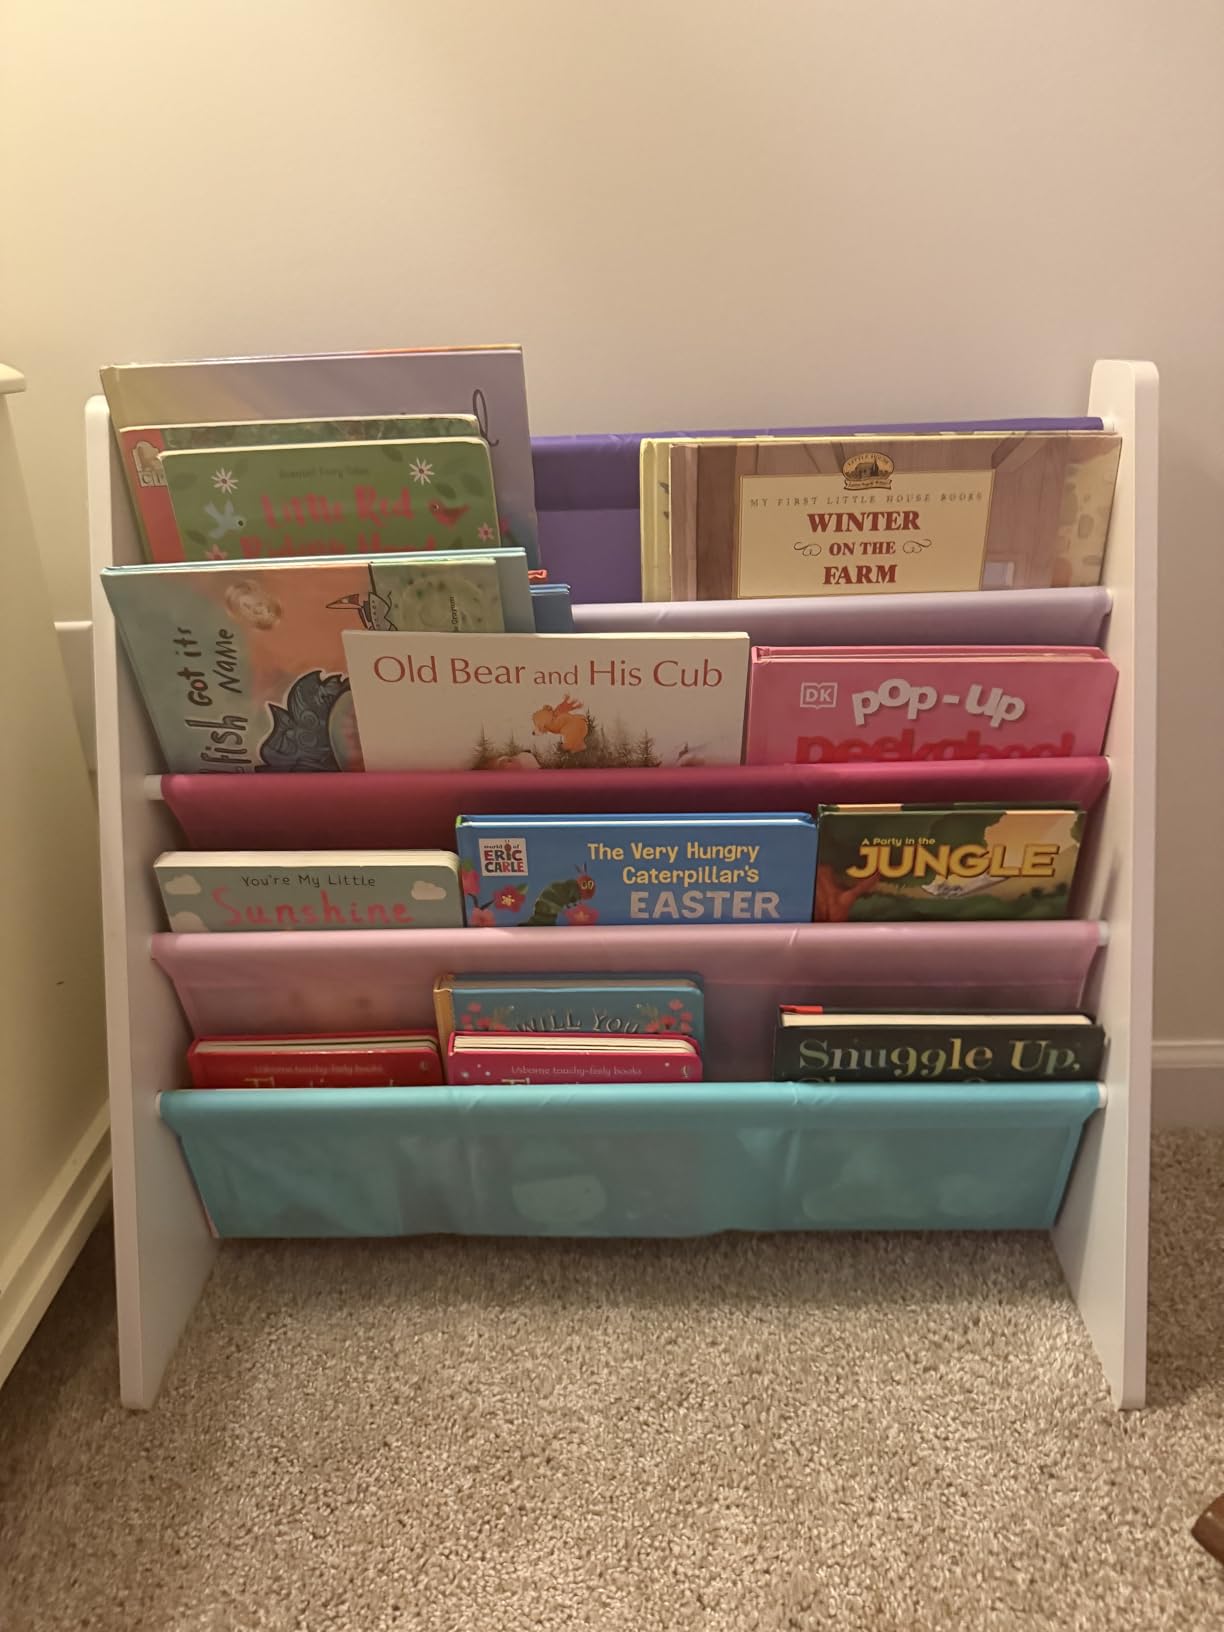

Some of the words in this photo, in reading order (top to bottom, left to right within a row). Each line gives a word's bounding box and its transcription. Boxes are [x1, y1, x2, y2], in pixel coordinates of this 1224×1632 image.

[260, 490, 345, 529] Little
[354, 484, 415, 528] Red
[750, 498, 769, 508] MY
[776, 496, 818, 507] FIRST
[826, 494, 877, 506] LITTLE
[885, 492, 931, 504] HOUSE
[940, 491, 983, 503] BOOKS
[807, 509, 921, 534] WINTER
[828, 541, 855, 556] ON
[859, 540, 897, 555] THE
[822, 563, 898, 586] FARM
[172, 626, 203, 658] its
[373, 653, 439, 685] Old
[450, 657, 527, 686] Bear
[533, 664, 579, 686] and
[588, 659, 643, 688] His
[652, 658, 724, 688] Cub
[176, 665, 214, 707] Got
[804, 688, 833, 703] DK
[587, 842, 624, 861] The
[630, 842, 678, 863] Very
[686, 841, 760, 863] Hungry
[861, 837, 871, 847] A
[872, 837, 903, 848] Party
[918, 836, 936, 846] the
[483, 849, 523, 862] ERIC
[845, 843, 1061, 880] JUNGLE
[484, 861, 525, 874] CARLE
[622, 865, 760, 888] Caterpillar's
[241, 873, 290, 888] You're
[298, 874, 321, 888] My
[327, 874, 377, 888] Little
[211, 884, 416, 928] Sunshine
[630, 890, 781, 920] EASTER
[513, 1010, 582, 1032] WILL
[591, 1007, 640, 1034] YOU
[799, 1037, 993, 1077] Snuggle
[511, 1065, 550, 1075] Usborne
[613, 1065, 642, 1076] books
